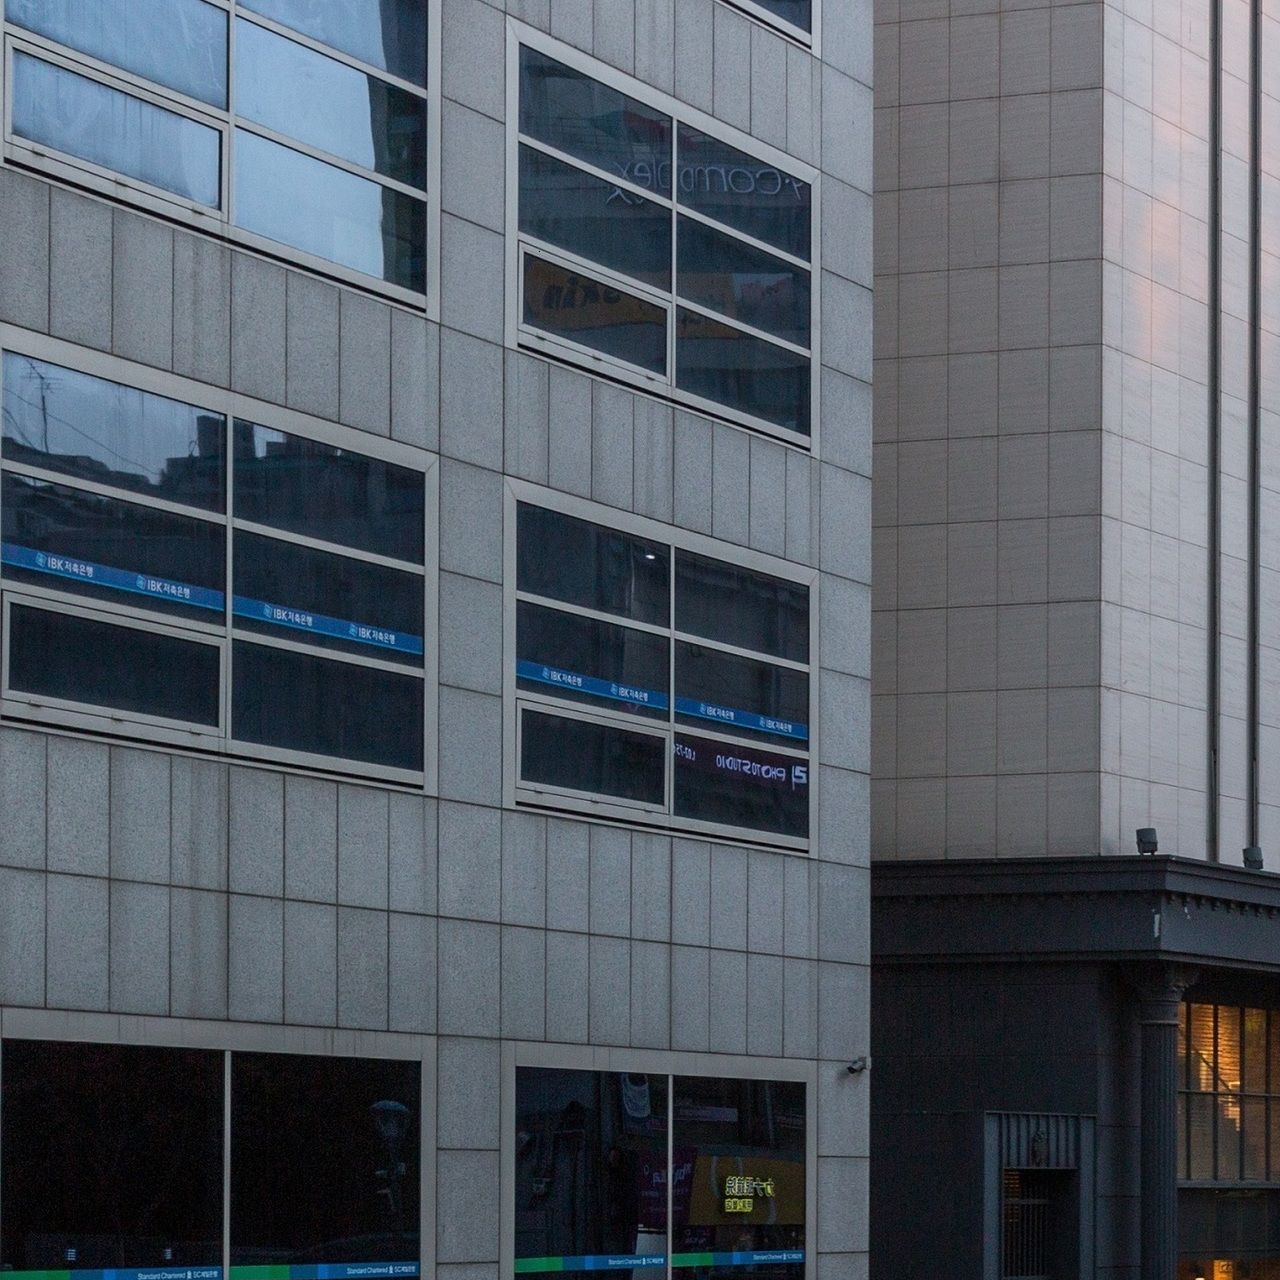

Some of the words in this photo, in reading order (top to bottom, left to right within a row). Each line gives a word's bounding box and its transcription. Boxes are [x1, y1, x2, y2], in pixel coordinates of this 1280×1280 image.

[48, 556, 64, 571] IBK
[65, 561, 94, 578] 저축은행
[147, 579, 163, 593] IBK
[163, 583, 191, 599] 저축은행
[273, 608, 288, 620] IBK
[288, 612, 313, 627] 저축은행
[358, 626, 372, 638] IBK
[372, 630, 396, 645] 저축은행
[550, 671, 562, 682] IBK
[618, 687, 629, 697] IBK
[137, 1273, 160, 1280] Standard
[161, 1272, 186, 1280] Chartered
[368, 1266, 388, 1274] Chartered
